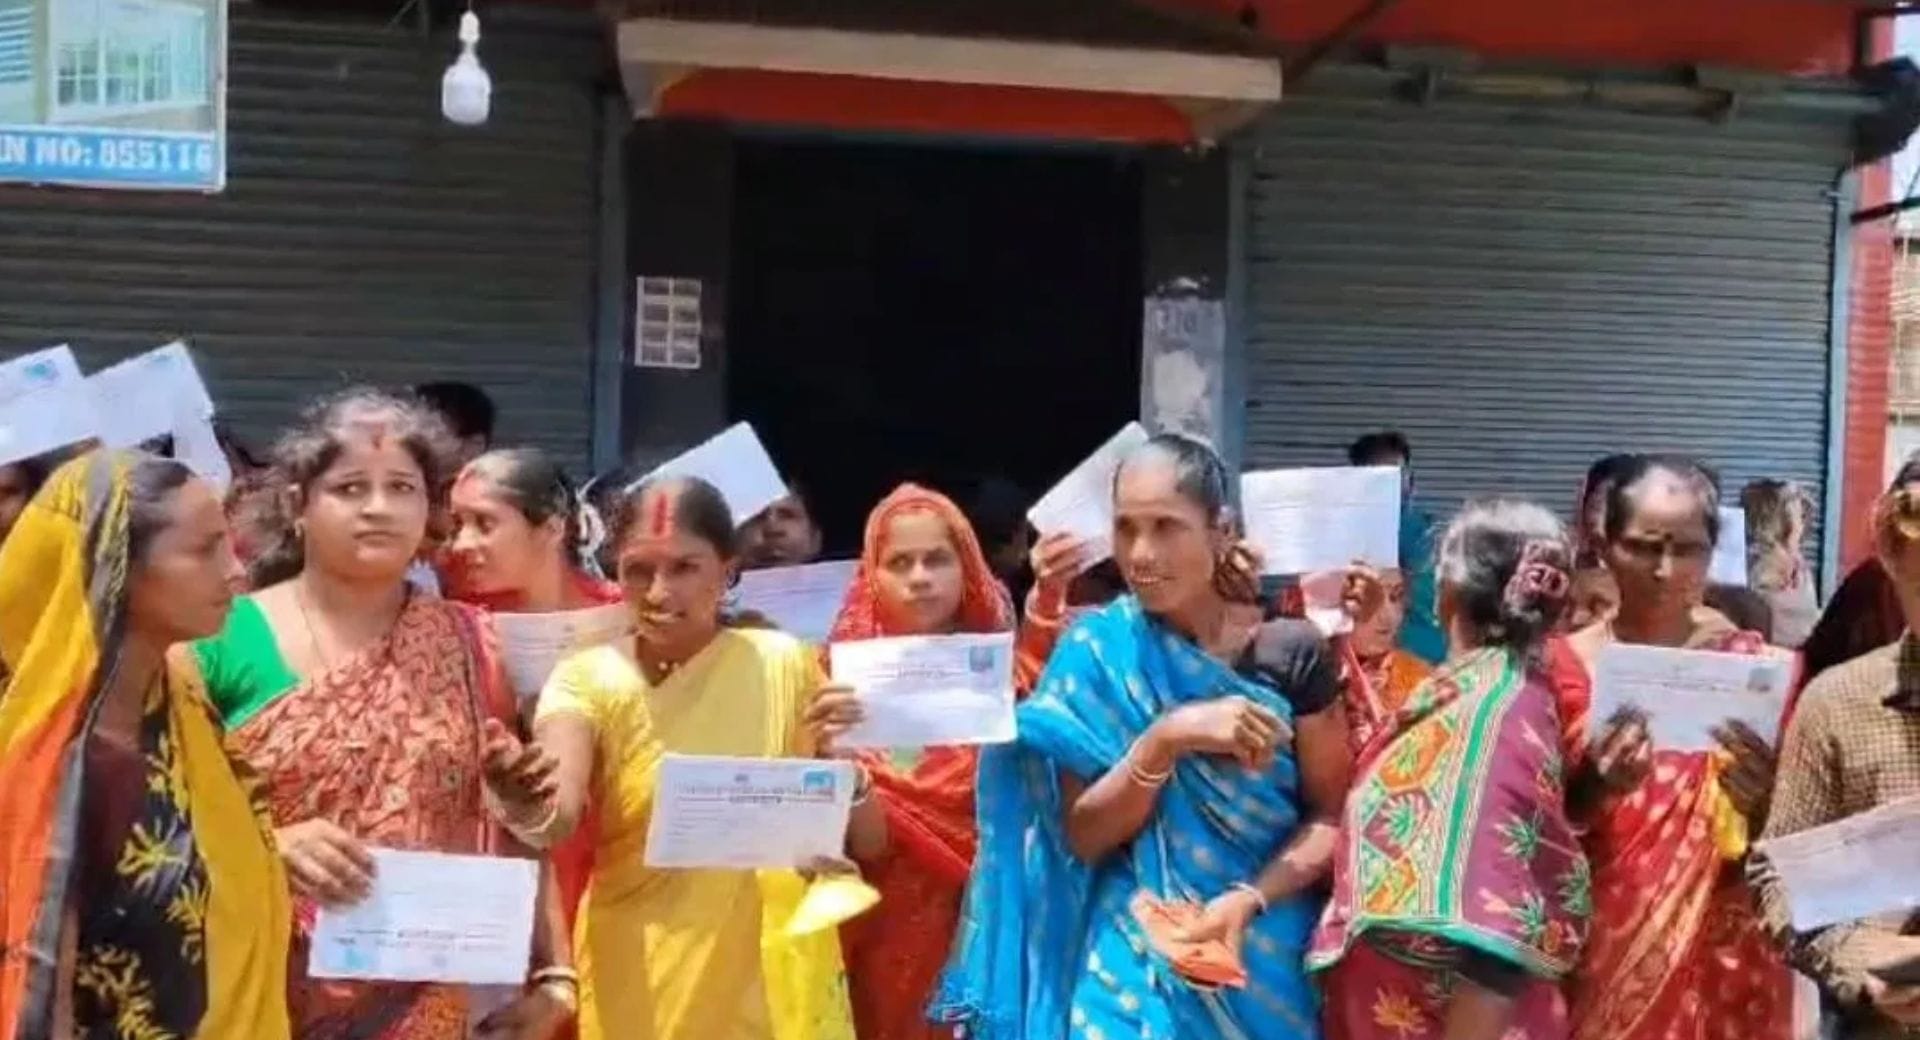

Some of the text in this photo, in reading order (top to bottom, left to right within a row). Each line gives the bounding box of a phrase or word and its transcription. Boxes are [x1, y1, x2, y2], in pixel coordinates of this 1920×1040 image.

[0, 134, 212, 171] N NO: 855116
